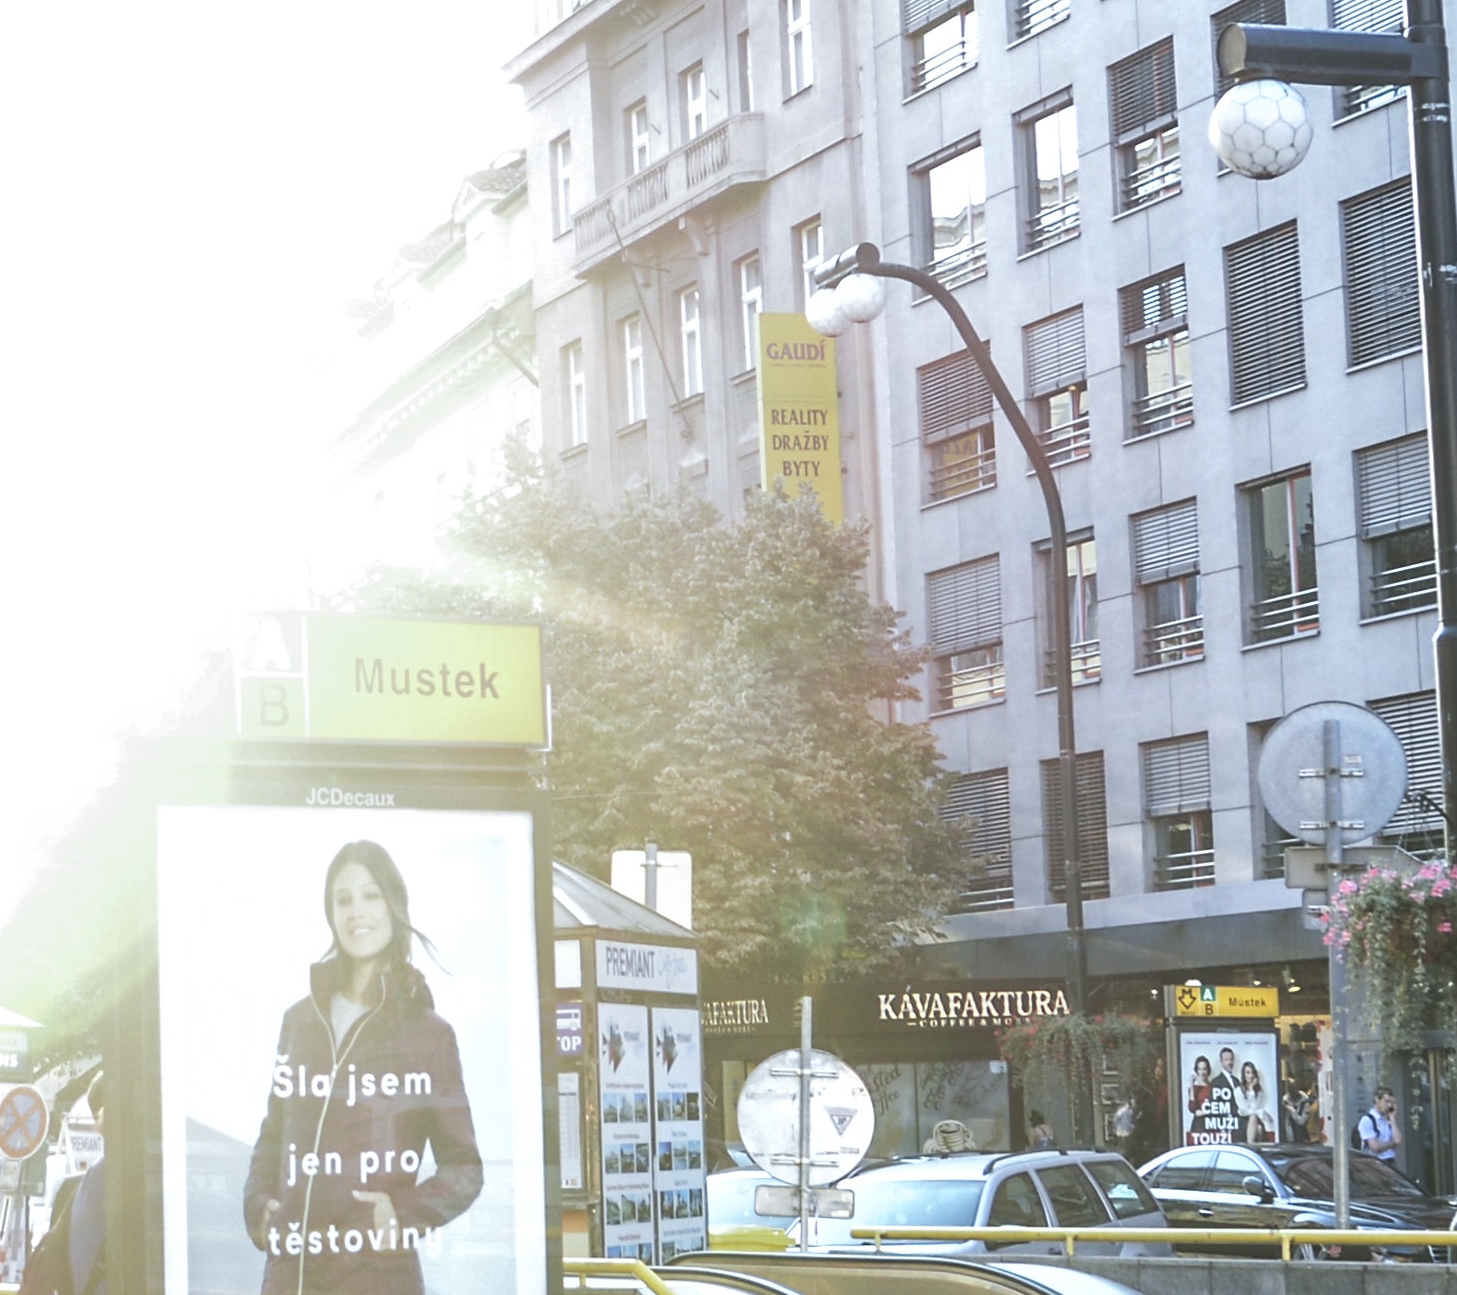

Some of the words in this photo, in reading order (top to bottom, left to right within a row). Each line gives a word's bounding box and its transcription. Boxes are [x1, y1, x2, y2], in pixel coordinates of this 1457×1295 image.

[766, 339, 827, 361] GAUDÍ
[771, 408, 828, 426] REALITY
[772, 430, 829, 452] DRAŽBY
[782, 460, 821, 477] BYTY
[252, 617, 291, 670] A
[259, 684, 290, 728] B
[305, 786, 396, 808] JCDecaux
[605, 945, 656, 979] PREMIANT
[878, 985, 1071, 1020] KÁVAFAKTURA
[1203, 988, 1214, 1000] A
[1205, 1003, 1214, 1016] B
[919, 1018, 977, 1028] COFFEE
[557, 1036, 582, 1052] OP
[272, 1053, 331, 1098] Šla
[346, 1063, 432, 1107] jsem
[1212, 1087, 1232, 1101] PO
[1201, 1098, 1231, 1115] ČEM
[1204, 1114, 1239, 1131] MUŽI
[1191, 1129, 1233, 1145] TOUŽÍ
[287, 1143, 342, 1187] jen
[359, 1148, 420, 1184] pro
[268, 1221, 443, 1260] těstoviny
